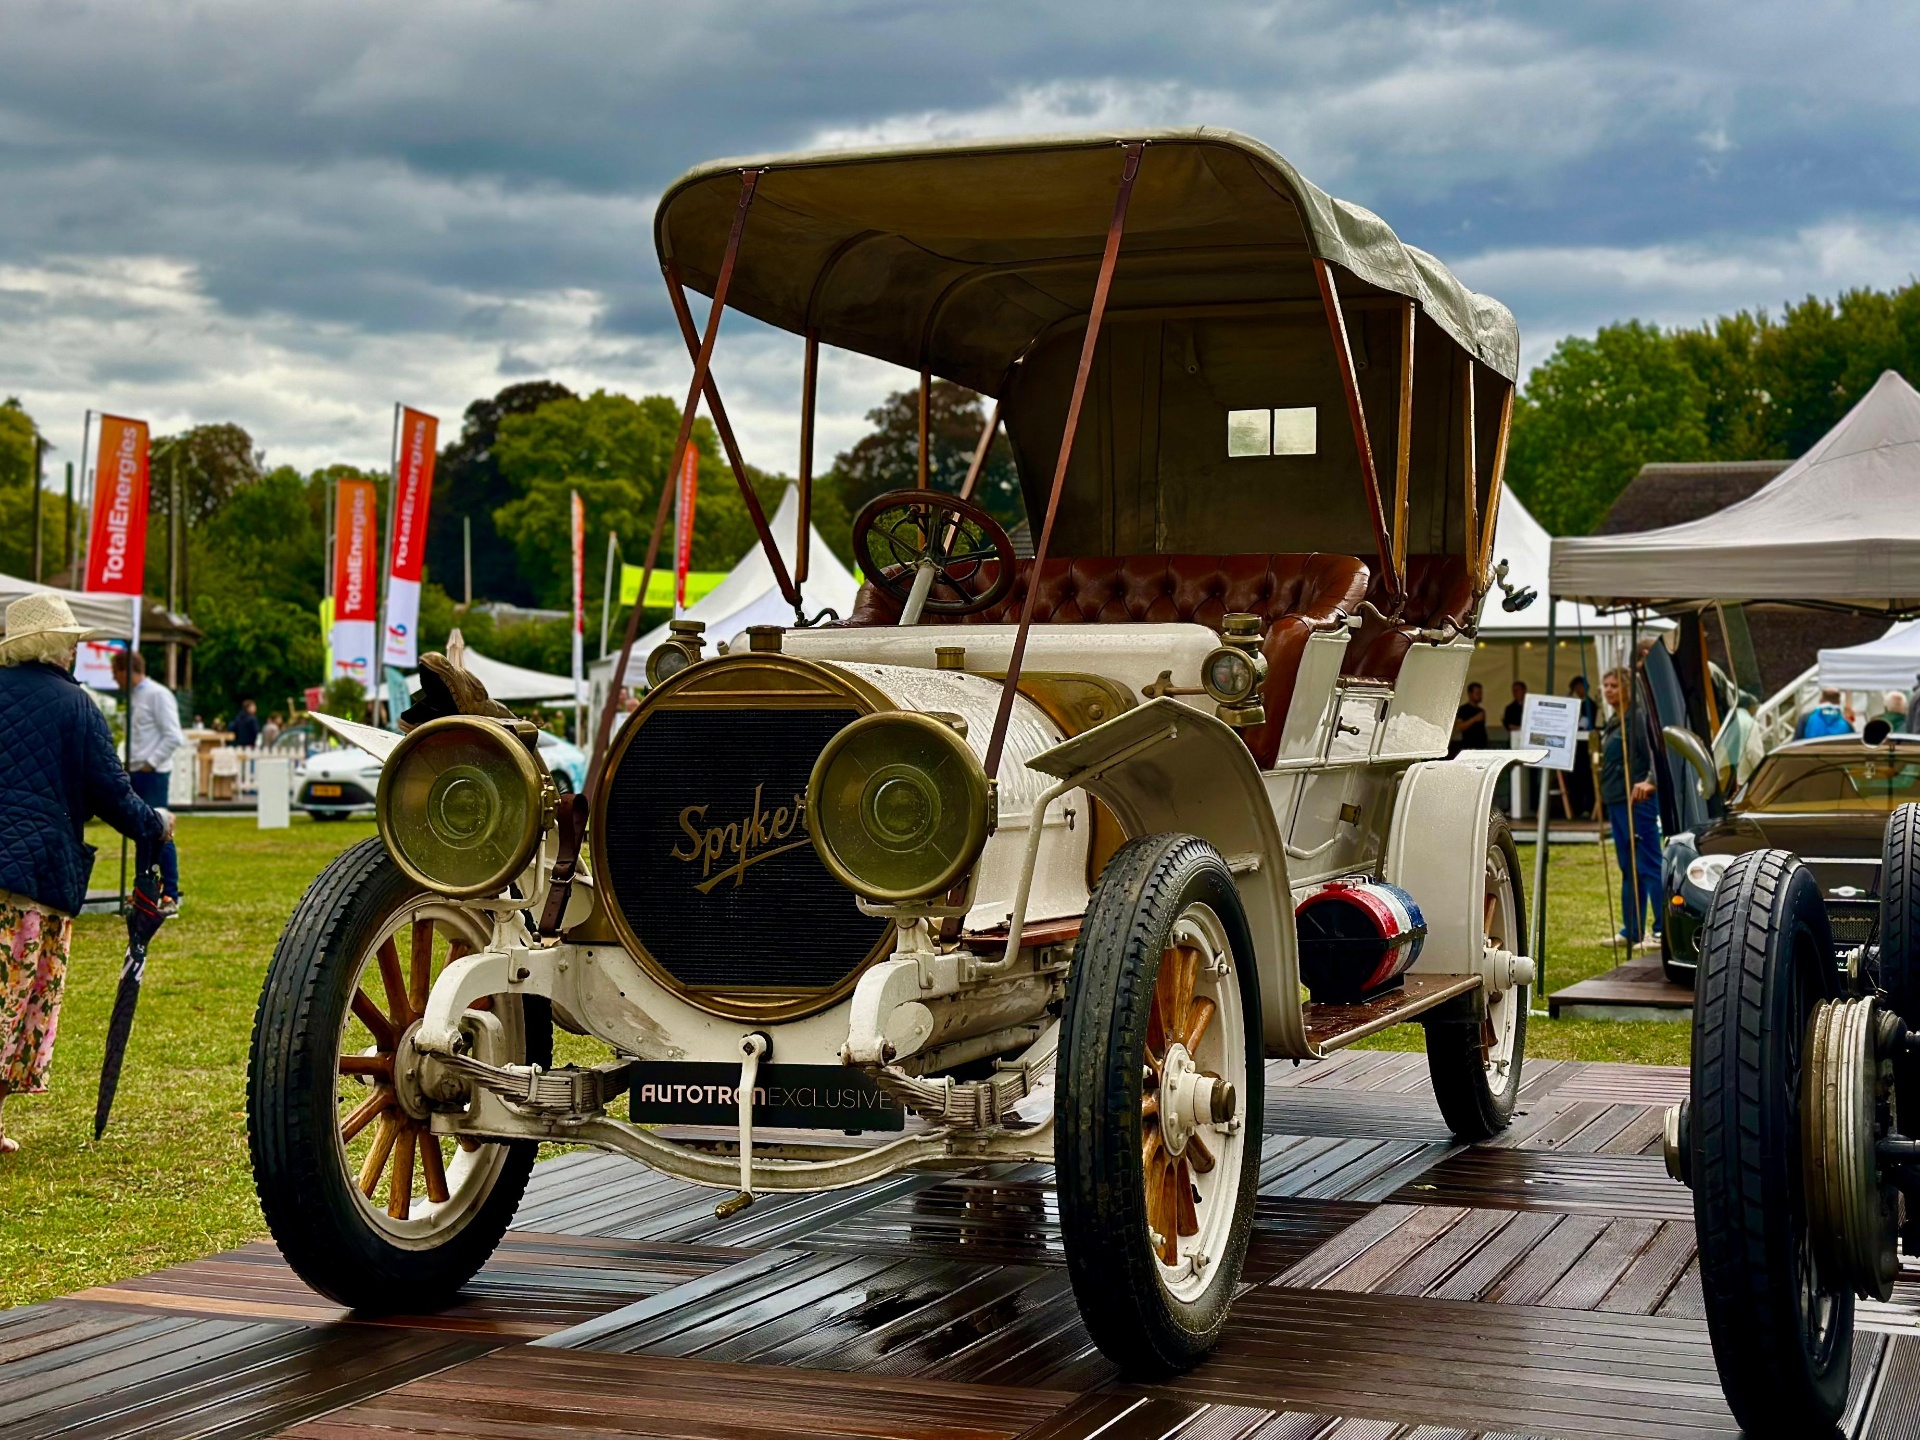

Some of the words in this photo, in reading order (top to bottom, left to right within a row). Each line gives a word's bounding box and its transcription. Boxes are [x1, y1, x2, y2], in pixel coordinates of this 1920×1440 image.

[102, 426, 138, 584] TotalEnergies
[344, 487, 367, 614] TotalEnergies
[396, 420, 426, 568] TotalEnergies
